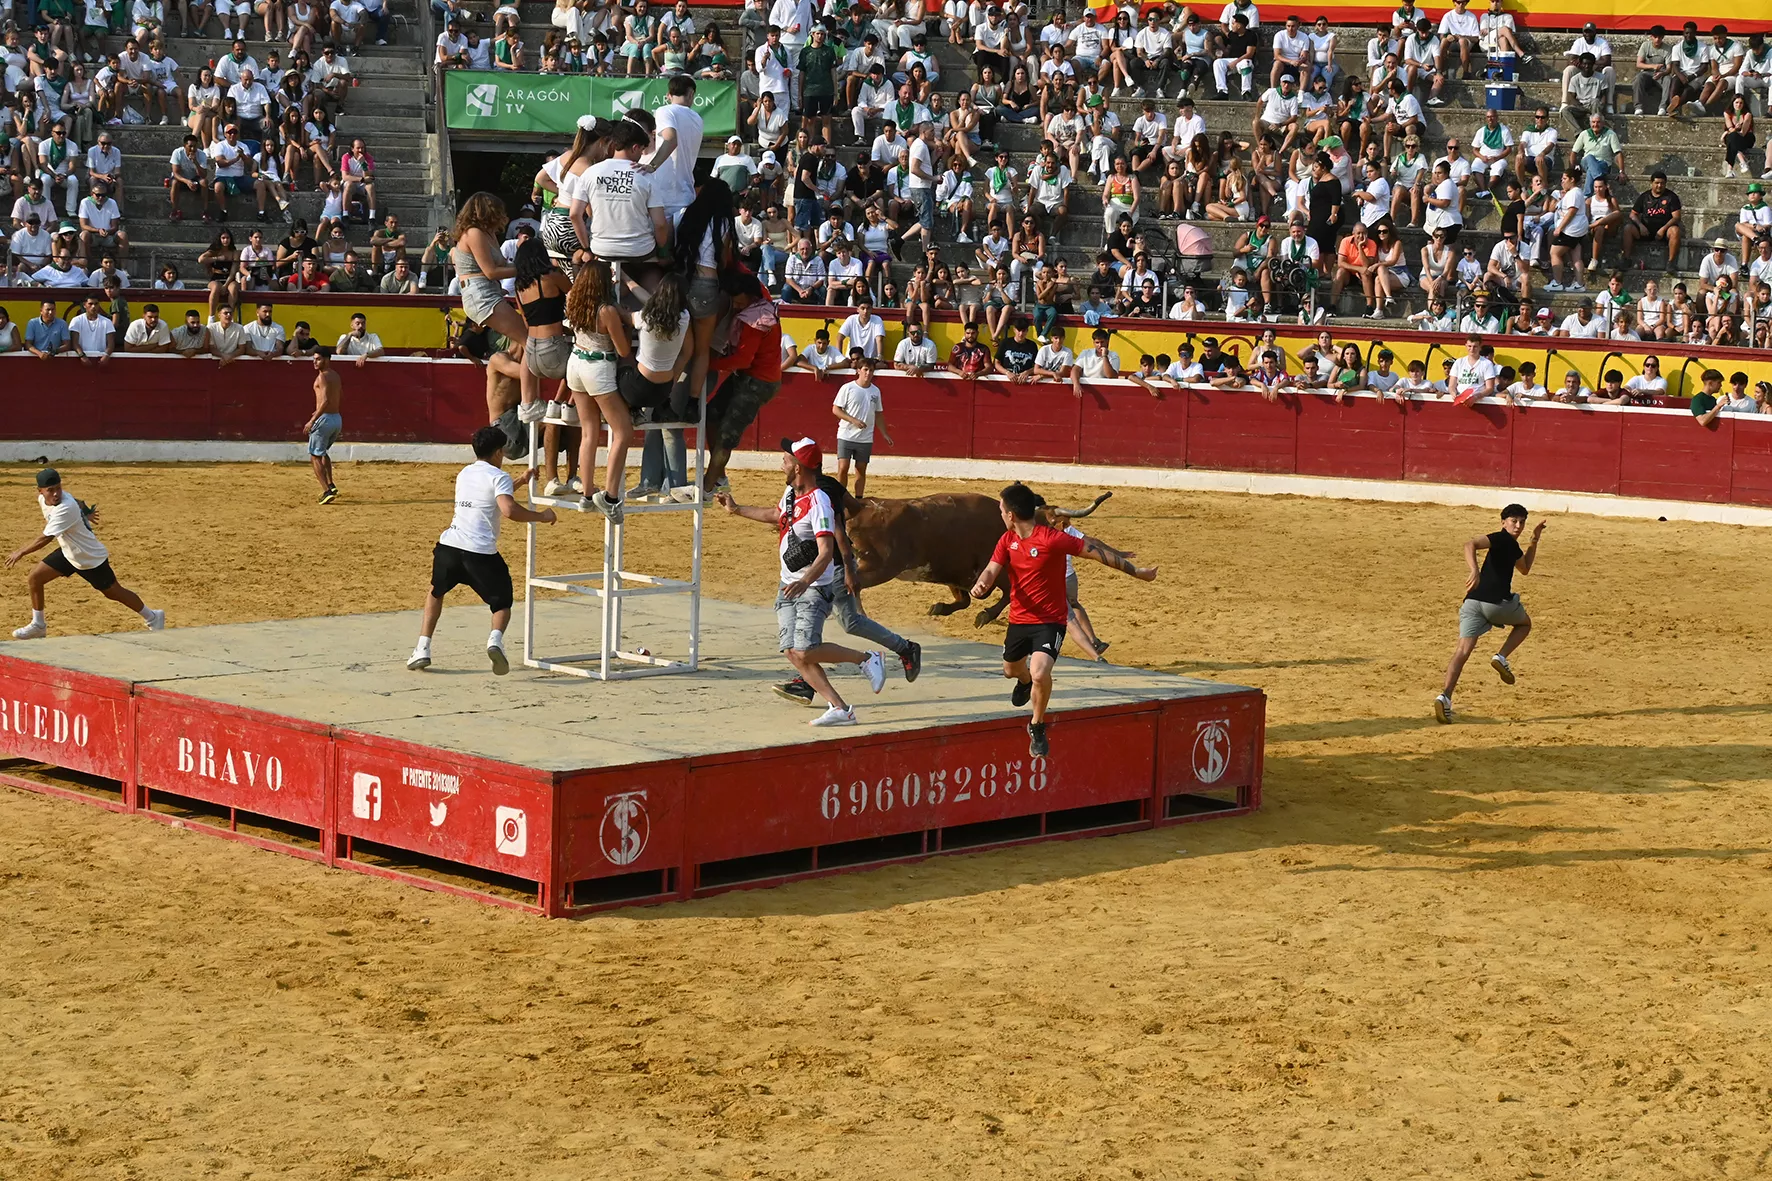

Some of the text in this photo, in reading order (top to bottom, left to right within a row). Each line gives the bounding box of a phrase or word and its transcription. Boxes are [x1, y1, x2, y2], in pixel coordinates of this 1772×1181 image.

[505, 88, 570, 102] ARAGÓN
[651, 93, 715, 107] ARÓN
[505, 103, 525, 114] TV
[596, 176, 634, 186] NORTH
[613, 170, 635, 178] THE
[606, 184, 632, 194] FACE
[177, 737, 283, 791] BRAVO
[409, 768, 432, 789] PATENTE
[821, 756, 1047, 820] 696052858
